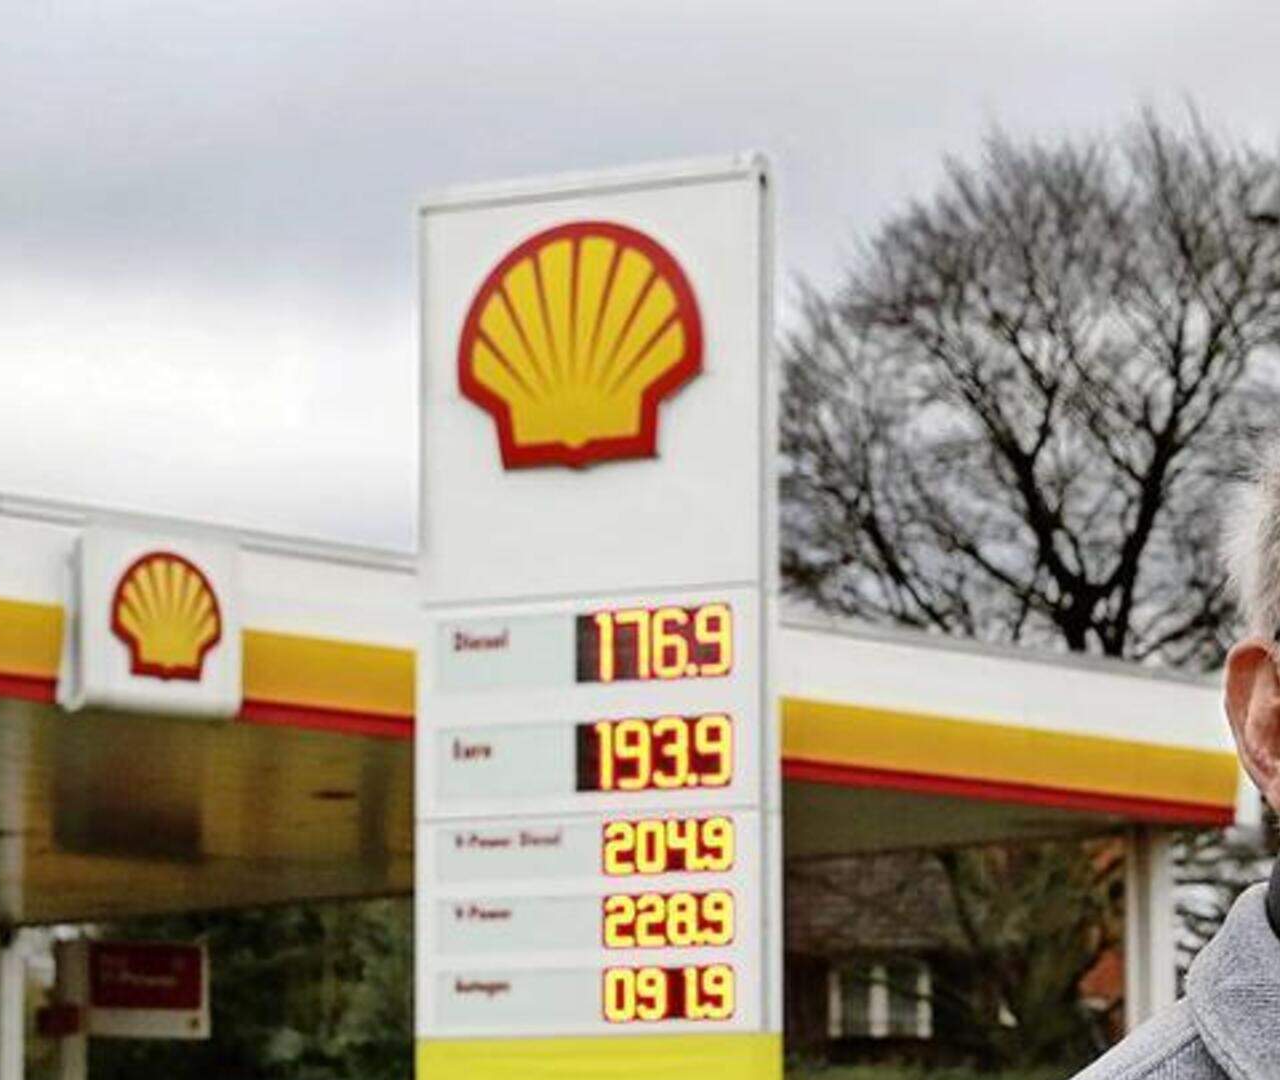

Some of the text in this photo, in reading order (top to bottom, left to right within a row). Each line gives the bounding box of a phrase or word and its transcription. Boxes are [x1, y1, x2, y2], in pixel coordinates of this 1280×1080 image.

[594, 602, 733, 683] 176.9
[594, 712, 733, 792] 193.9
[603, 815, 735, 876] 204.9
[603, 890, 735, 949] 228.9
[603, 964, 735, 1023] 091.9
